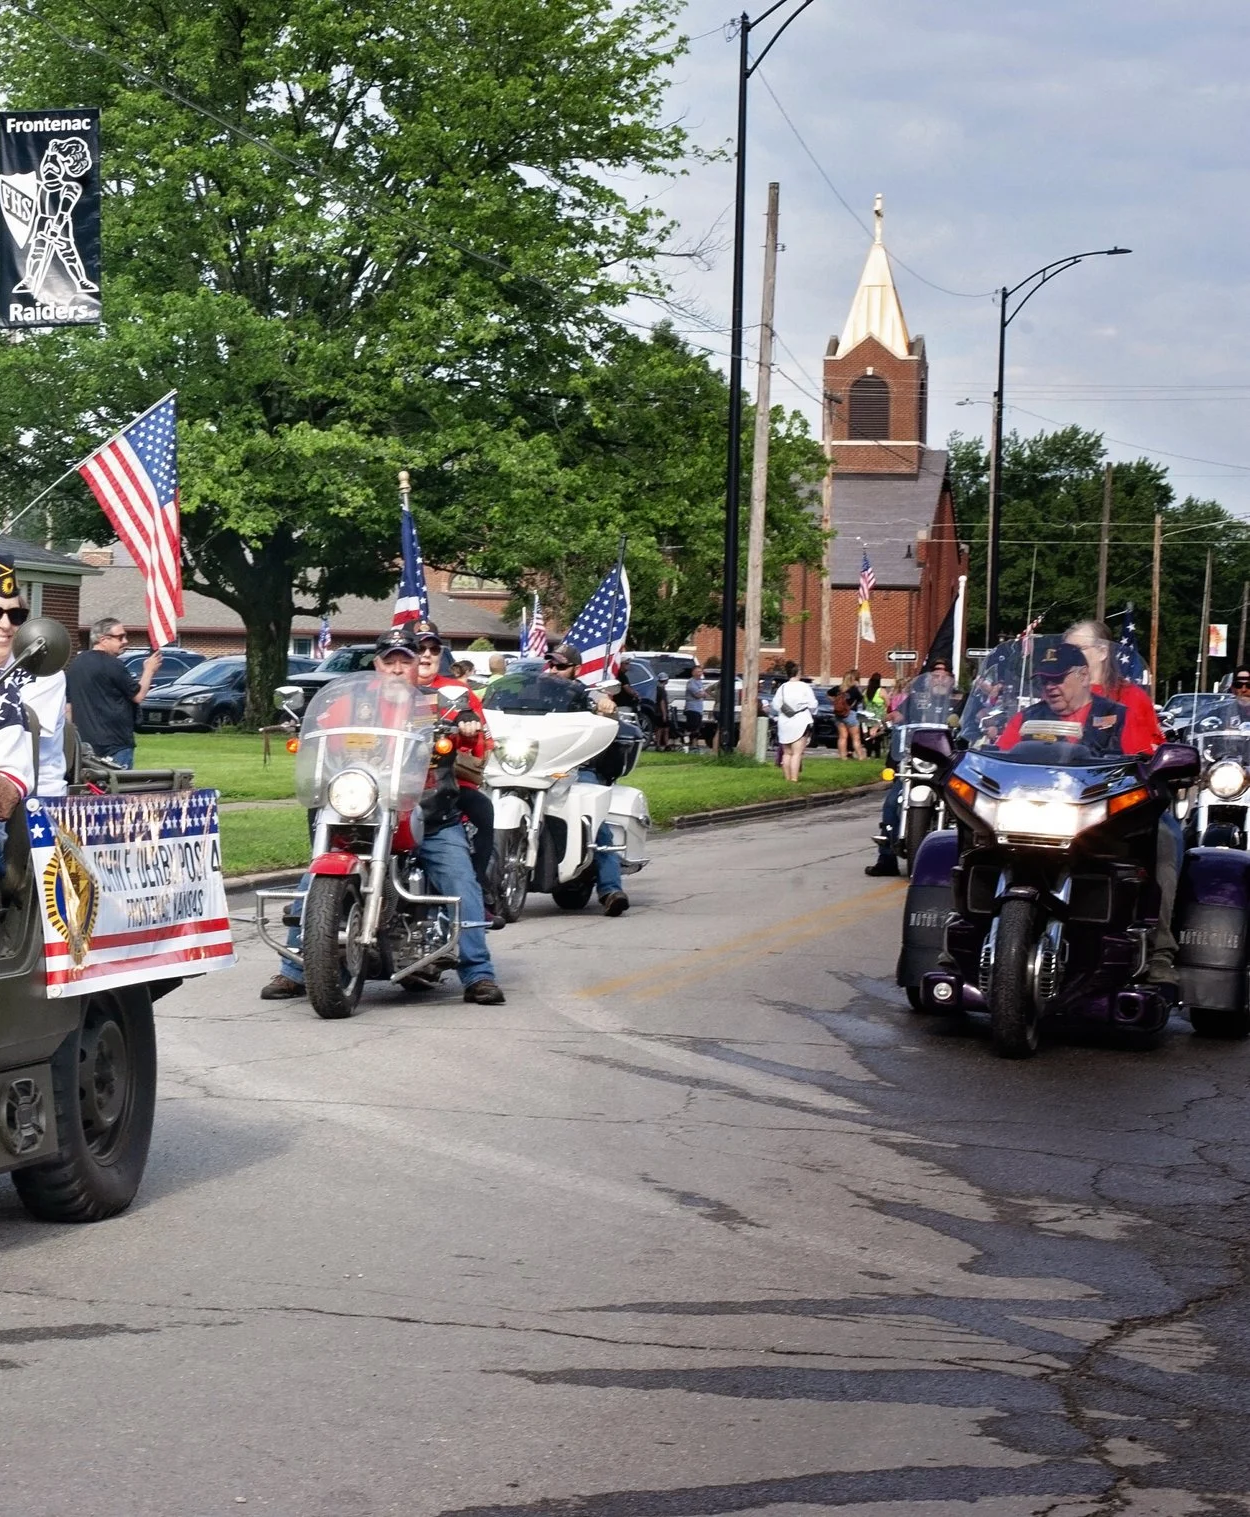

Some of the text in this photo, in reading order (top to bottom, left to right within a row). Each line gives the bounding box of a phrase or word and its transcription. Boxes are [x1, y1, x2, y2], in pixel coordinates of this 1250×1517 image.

[6, 117, 91, 133] Frontenac
[1, 182, 33, 222] FHS
[9, 302, 88, 322] Raiders
[174, 889, 203, 918] KANSAS
